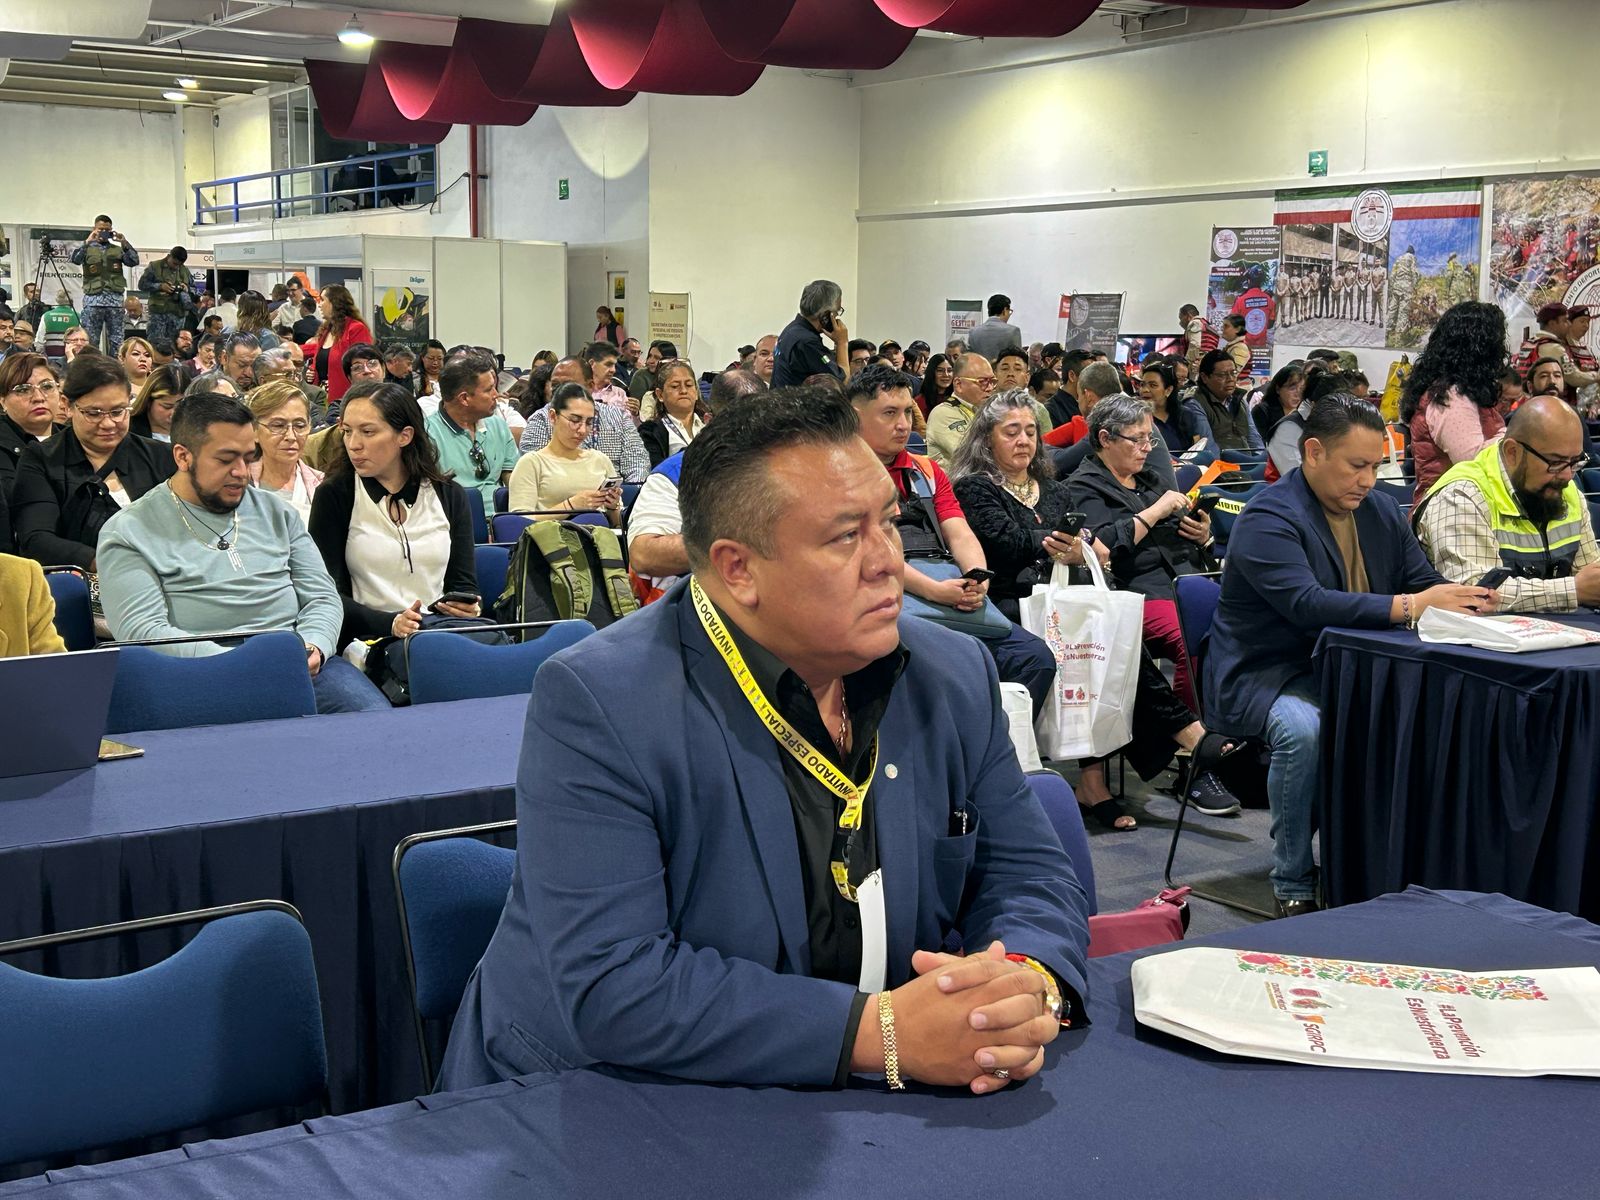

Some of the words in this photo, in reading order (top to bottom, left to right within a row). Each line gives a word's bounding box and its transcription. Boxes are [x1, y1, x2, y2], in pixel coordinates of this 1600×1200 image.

[701, 603, 733, 655] INVITADO
[764, 709, 808, 758] ESPECIAL
[808, 756, 854, 798] INVITADO
[1303, 1023, 1327, 1053] SGIRPC
